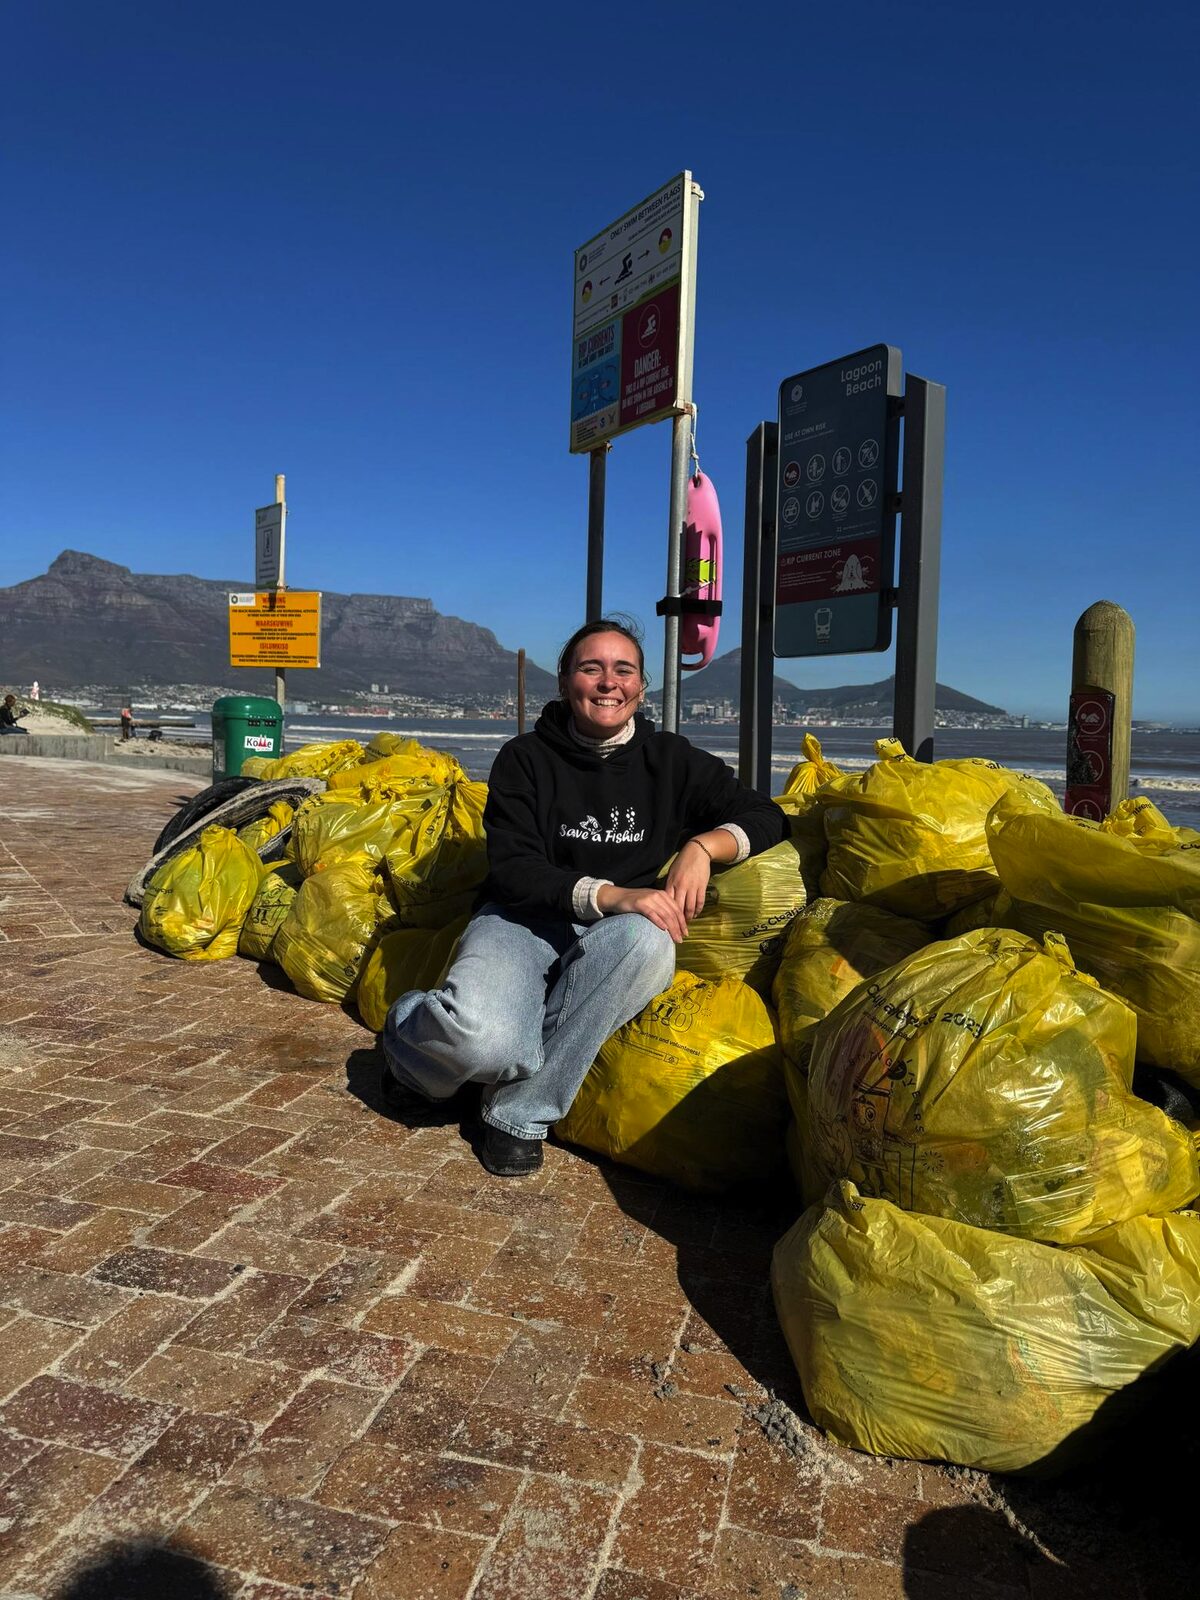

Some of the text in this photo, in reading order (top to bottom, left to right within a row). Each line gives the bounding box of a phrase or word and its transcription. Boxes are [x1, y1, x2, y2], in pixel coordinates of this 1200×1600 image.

[610, 224, 624, 240] ONLY
[623, 214, 638, 231] SWIM
[638, 196, 663, 220] BETWEEN
[663, 184, 681, 202] FLAGS
[841, 359, 882, 383] Lagoon
[846, 374, 882, 397] Beach
[796, 551, 824, 564] CURRENT
[823, 547, 842, 559] ZONE
[559, 823, 646, 844] Save a Fishie!
[741, 923, 768, 938] Let's
[941, 1011, 984, 1039] 2023
